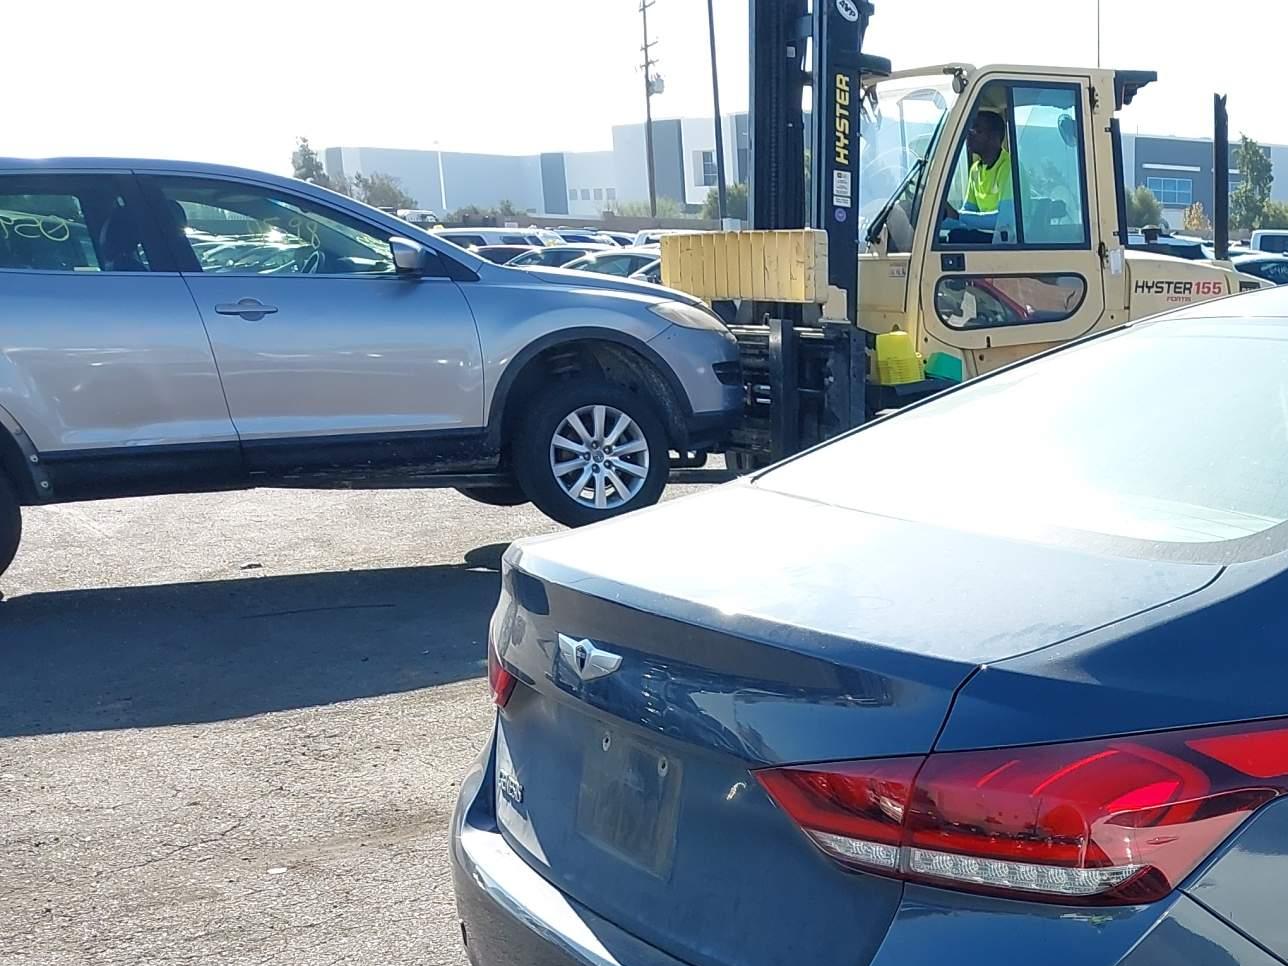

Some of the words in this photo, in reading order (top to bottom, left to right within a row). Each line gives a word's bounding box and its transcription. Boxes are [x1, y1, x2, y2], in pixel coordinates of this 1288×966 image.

[835, 73, 850, 166] HYSTER
[1135, 280, 1192, 294] HYSTER
[1195, 281, 1222, 295] 155
